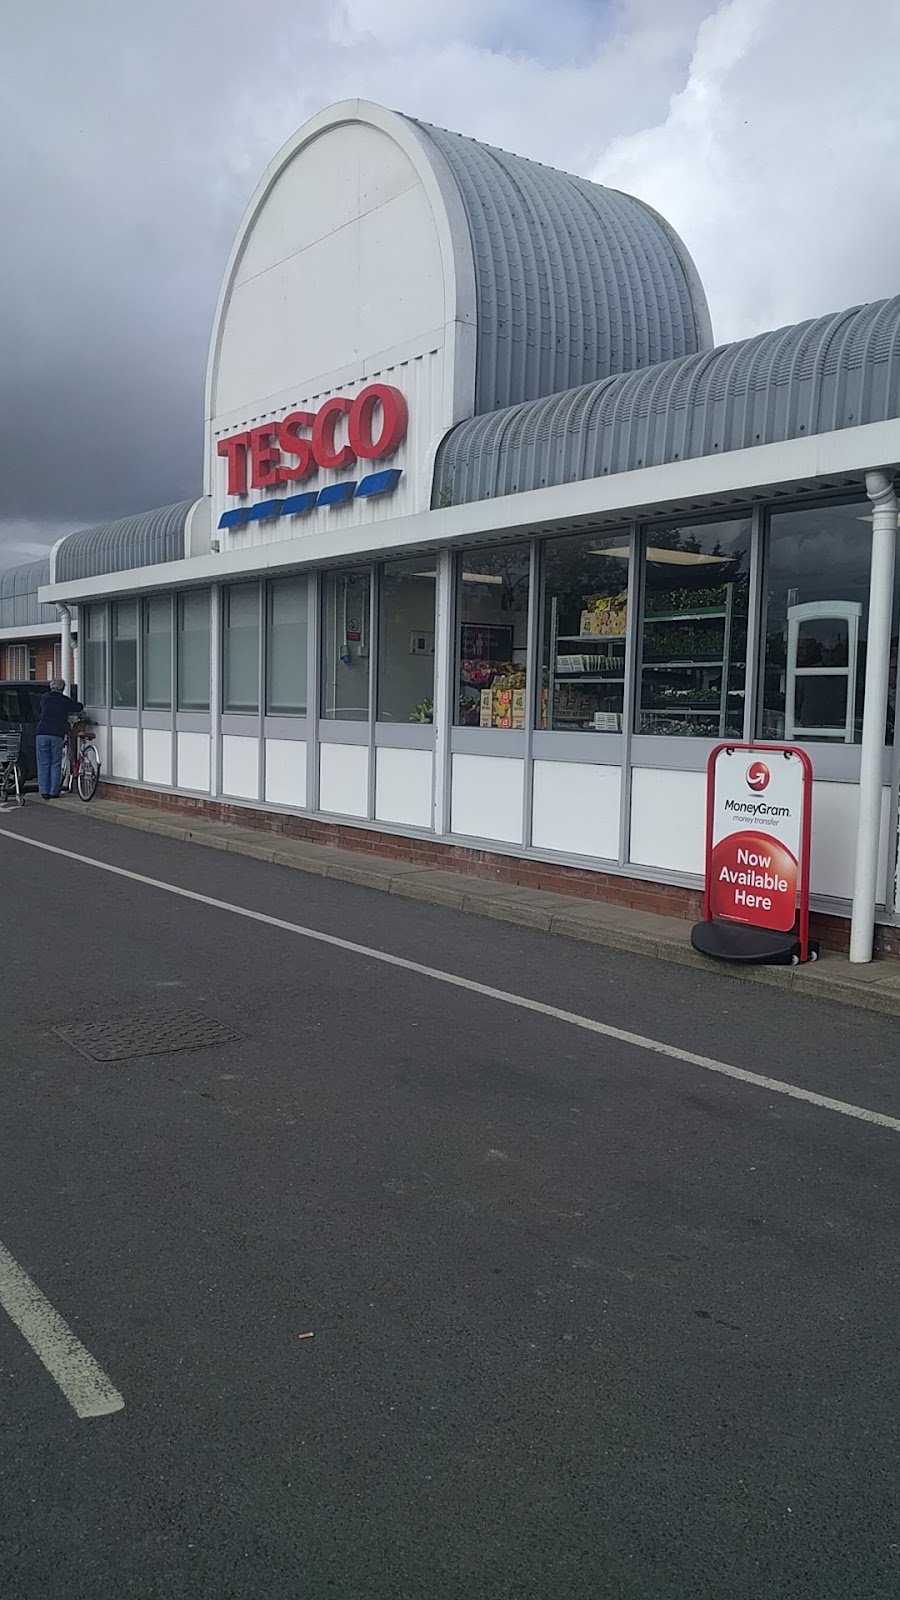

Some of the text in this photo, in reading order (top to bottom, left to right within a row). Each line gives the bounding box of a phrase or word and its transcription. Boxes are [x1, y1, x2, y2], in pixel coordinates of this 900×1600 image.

[217, 383, 408, 496] TESCO
[724, 800, 790, 816] MoneyGram
[733, 815, 779, 826] money transfer
[737, 848, 771, 868] Now
[719, 866, 788, 892] Available
[735, 889, 772, 910] Here
